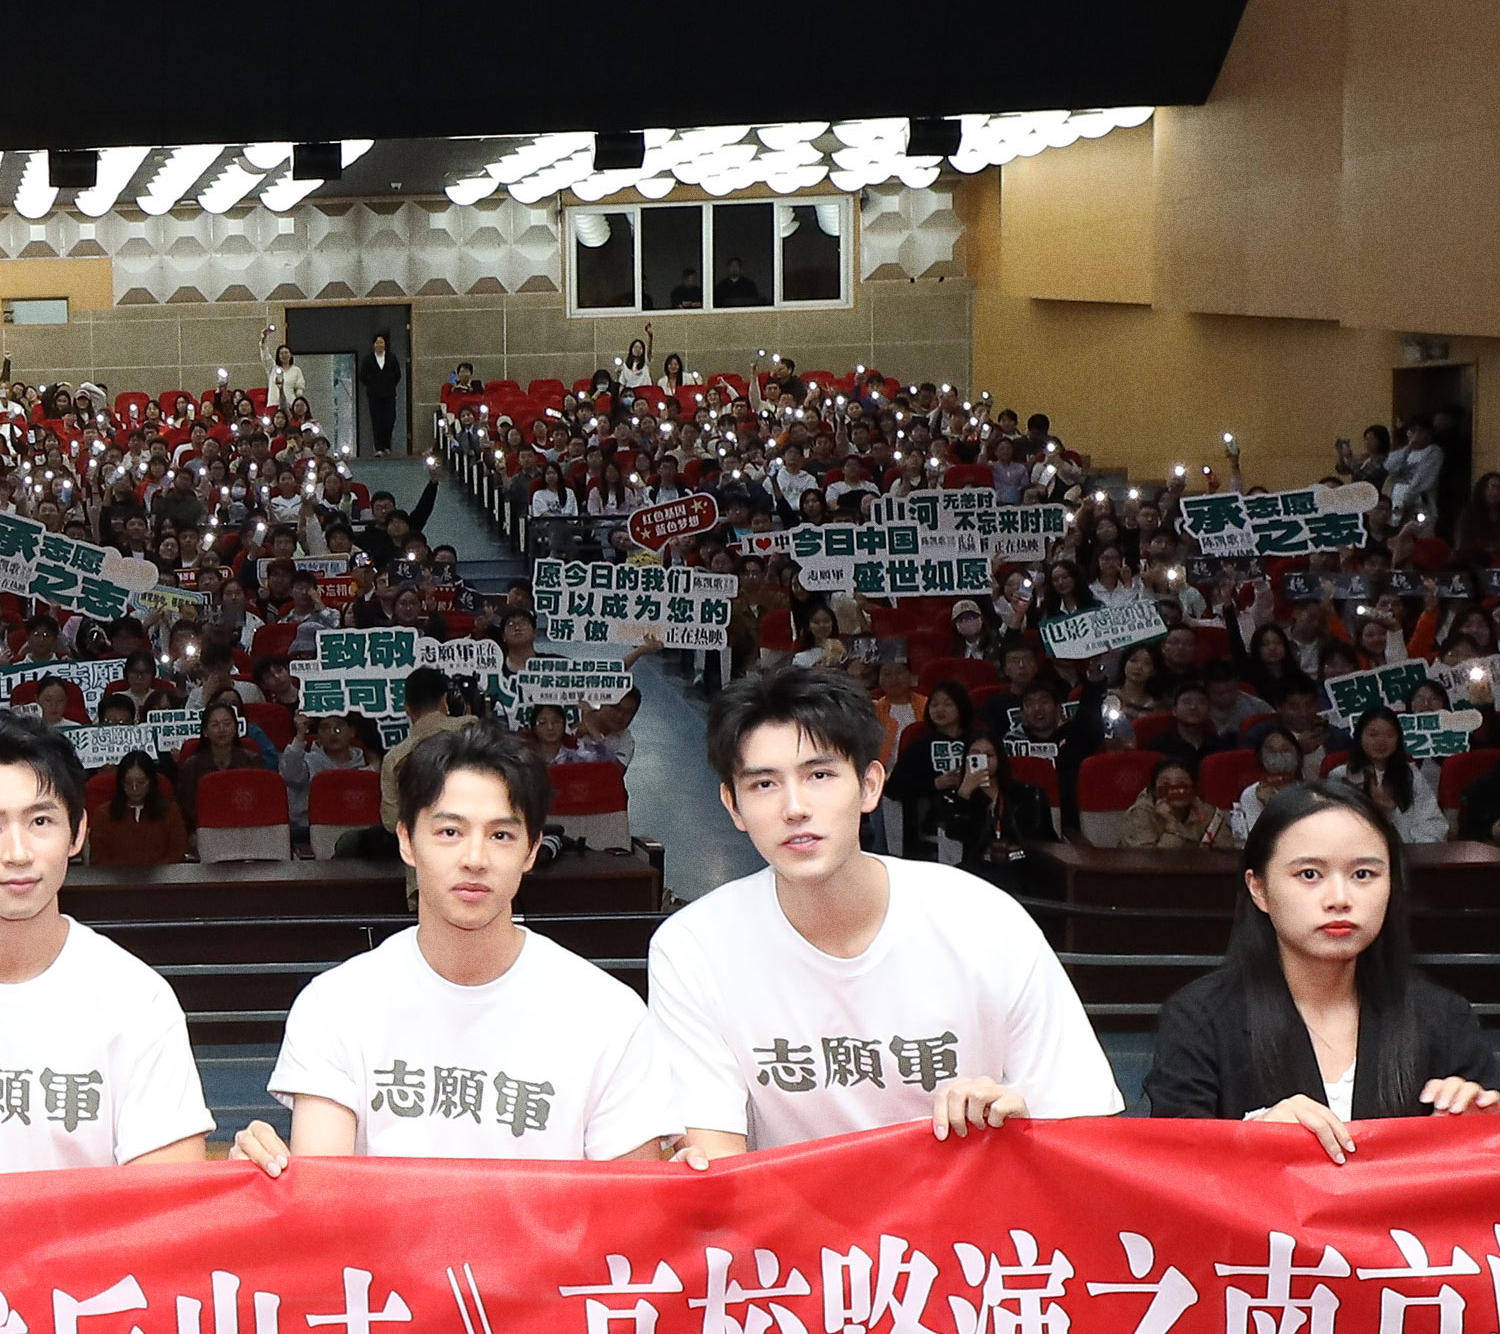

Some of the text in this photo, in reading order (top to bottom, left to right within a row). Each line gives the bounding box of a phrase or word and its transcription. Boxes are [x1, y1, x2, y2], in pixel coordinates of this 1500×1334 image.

[944, 493, 994, 510] 无恙时
[954, 509, 1064, 535] 不忘来时路
[792, 527, 919, 557] 今日中国
[535, 561, 691, 594] 愿今日的我们
[854, 558, 992, 593] 盛世如愿
[536, 590, 728, 625] 可以成为您的
[550, 618, 725, 646] 骄傲 正在热映
[319, 631, 416, 669] 致敬
[753, 1030, 959, 1093] 志願軍
[371, 1058, 556, 1139] 志願軍
